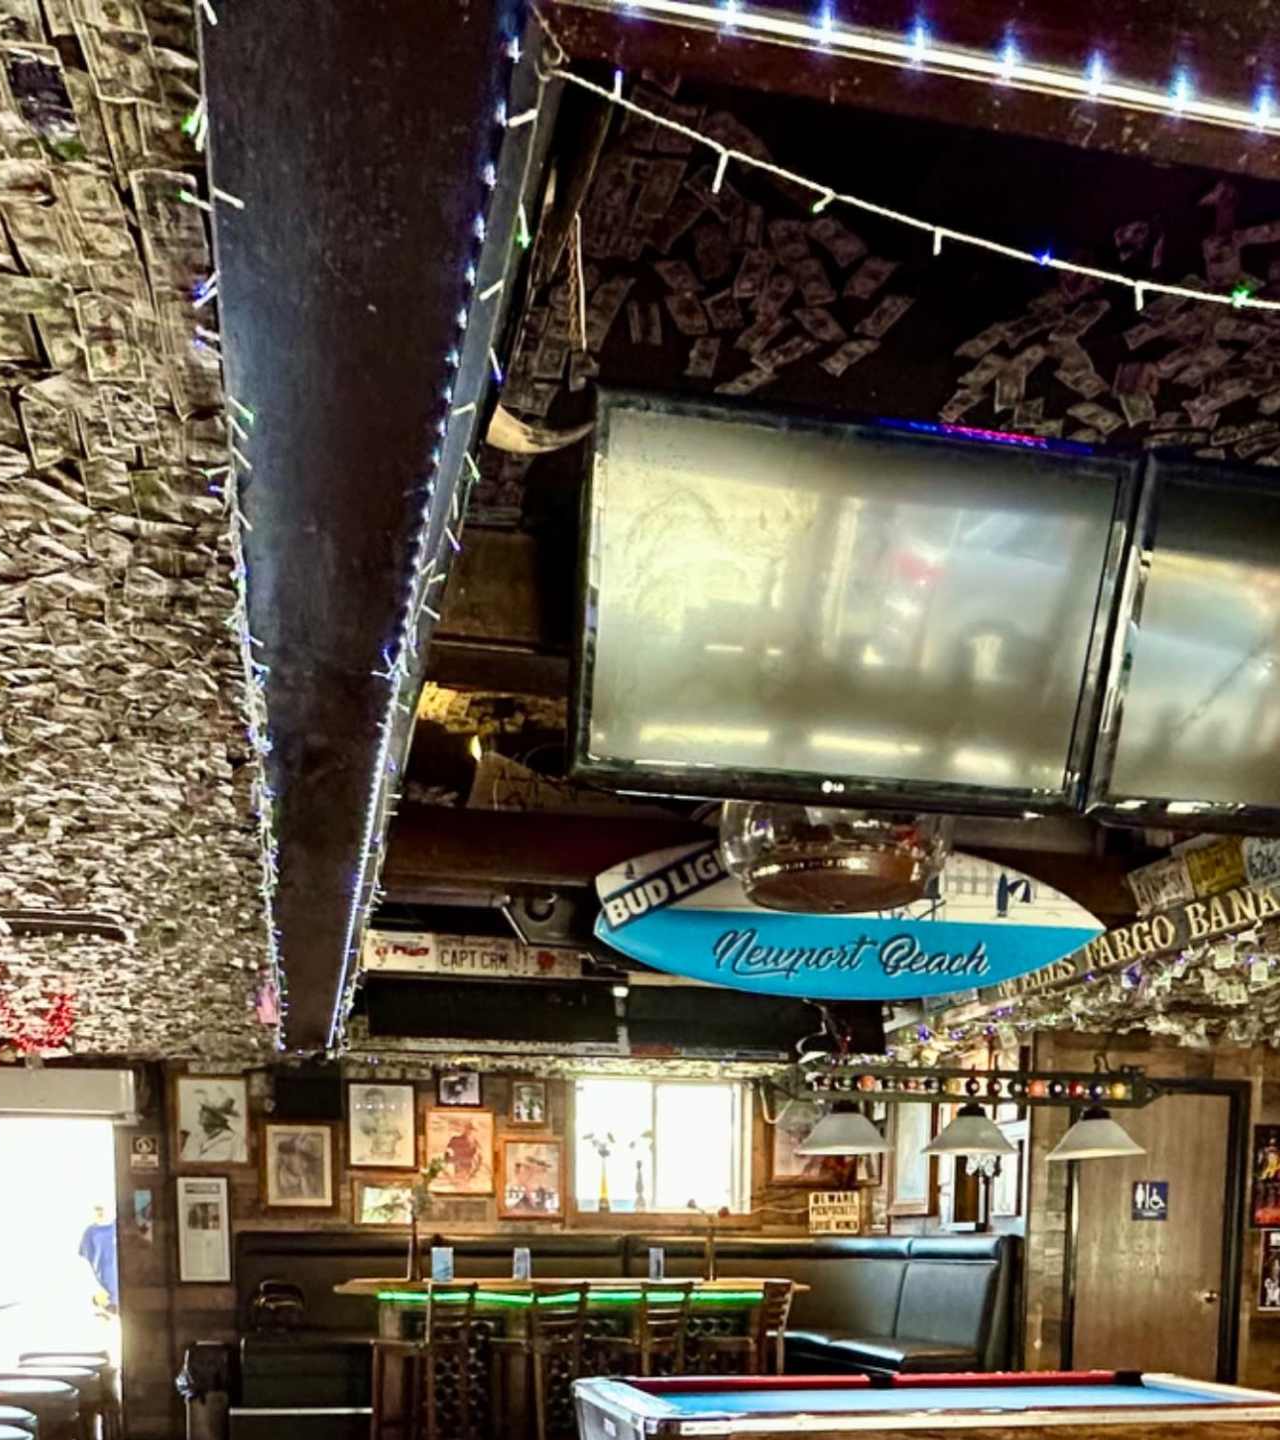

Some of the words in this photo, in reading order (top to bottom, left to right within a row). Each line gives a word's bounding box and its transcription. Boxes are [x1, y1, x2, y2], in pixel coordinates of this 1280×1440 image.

[605, 882, 669, 926] BUD
[667, 851, 722, 899] LIG
[440, 951, 475, 969] CAPT
[713, 927, 877, 980] Newport
[880, 935, 991, 977] Beach
[1085, 916, 1175, 971] FARGO
